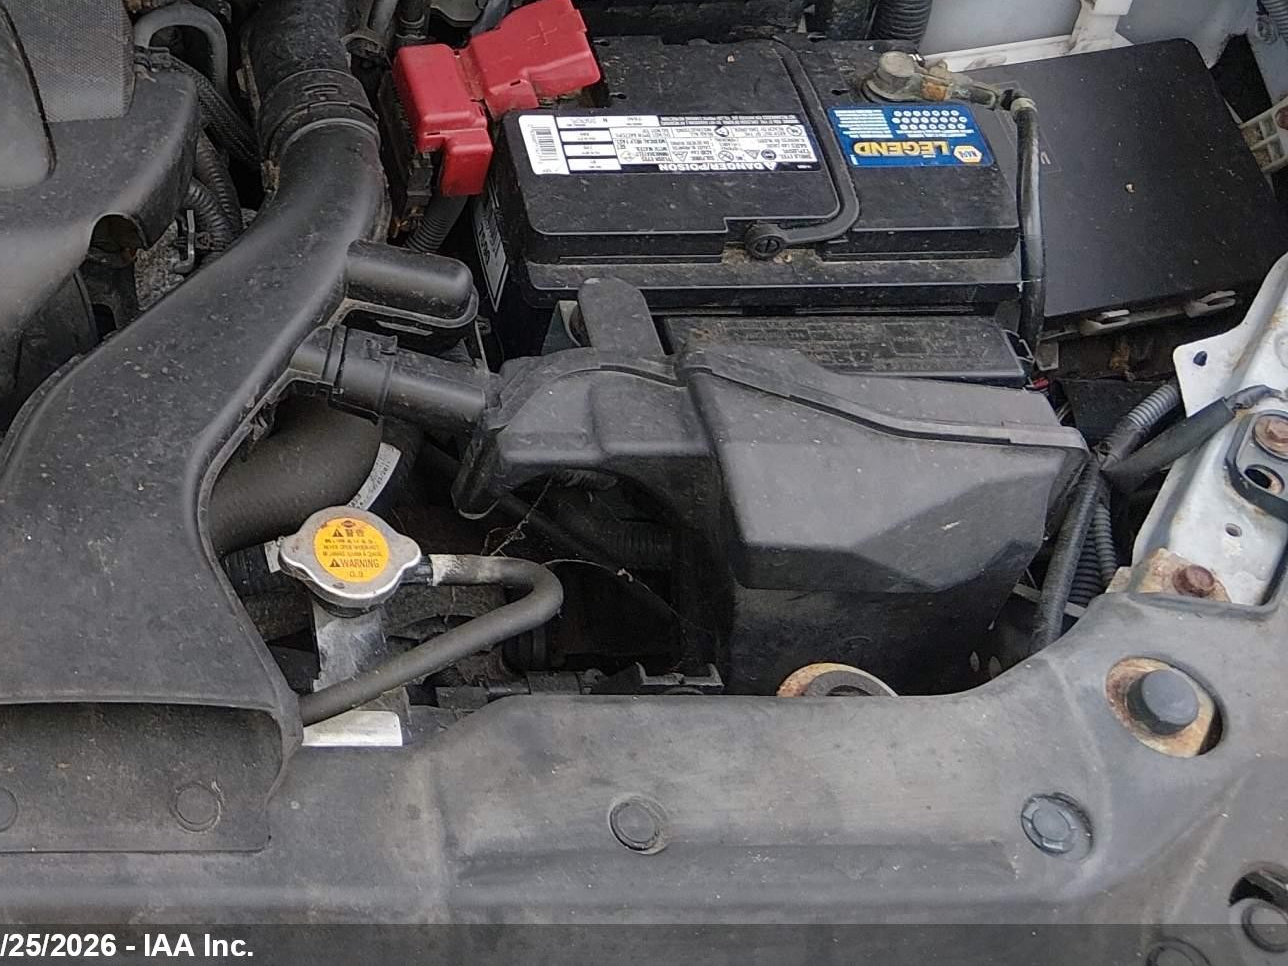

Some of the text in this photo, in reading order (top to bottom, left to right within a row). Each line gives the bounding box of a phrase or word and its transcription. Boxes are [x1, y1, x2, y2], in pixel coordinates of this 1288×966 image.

[853, 141, 950, 156] LEGEND
[658, 162, 765, 171] DANGER/POISON
[340, 558, 380, 568] WARNING
